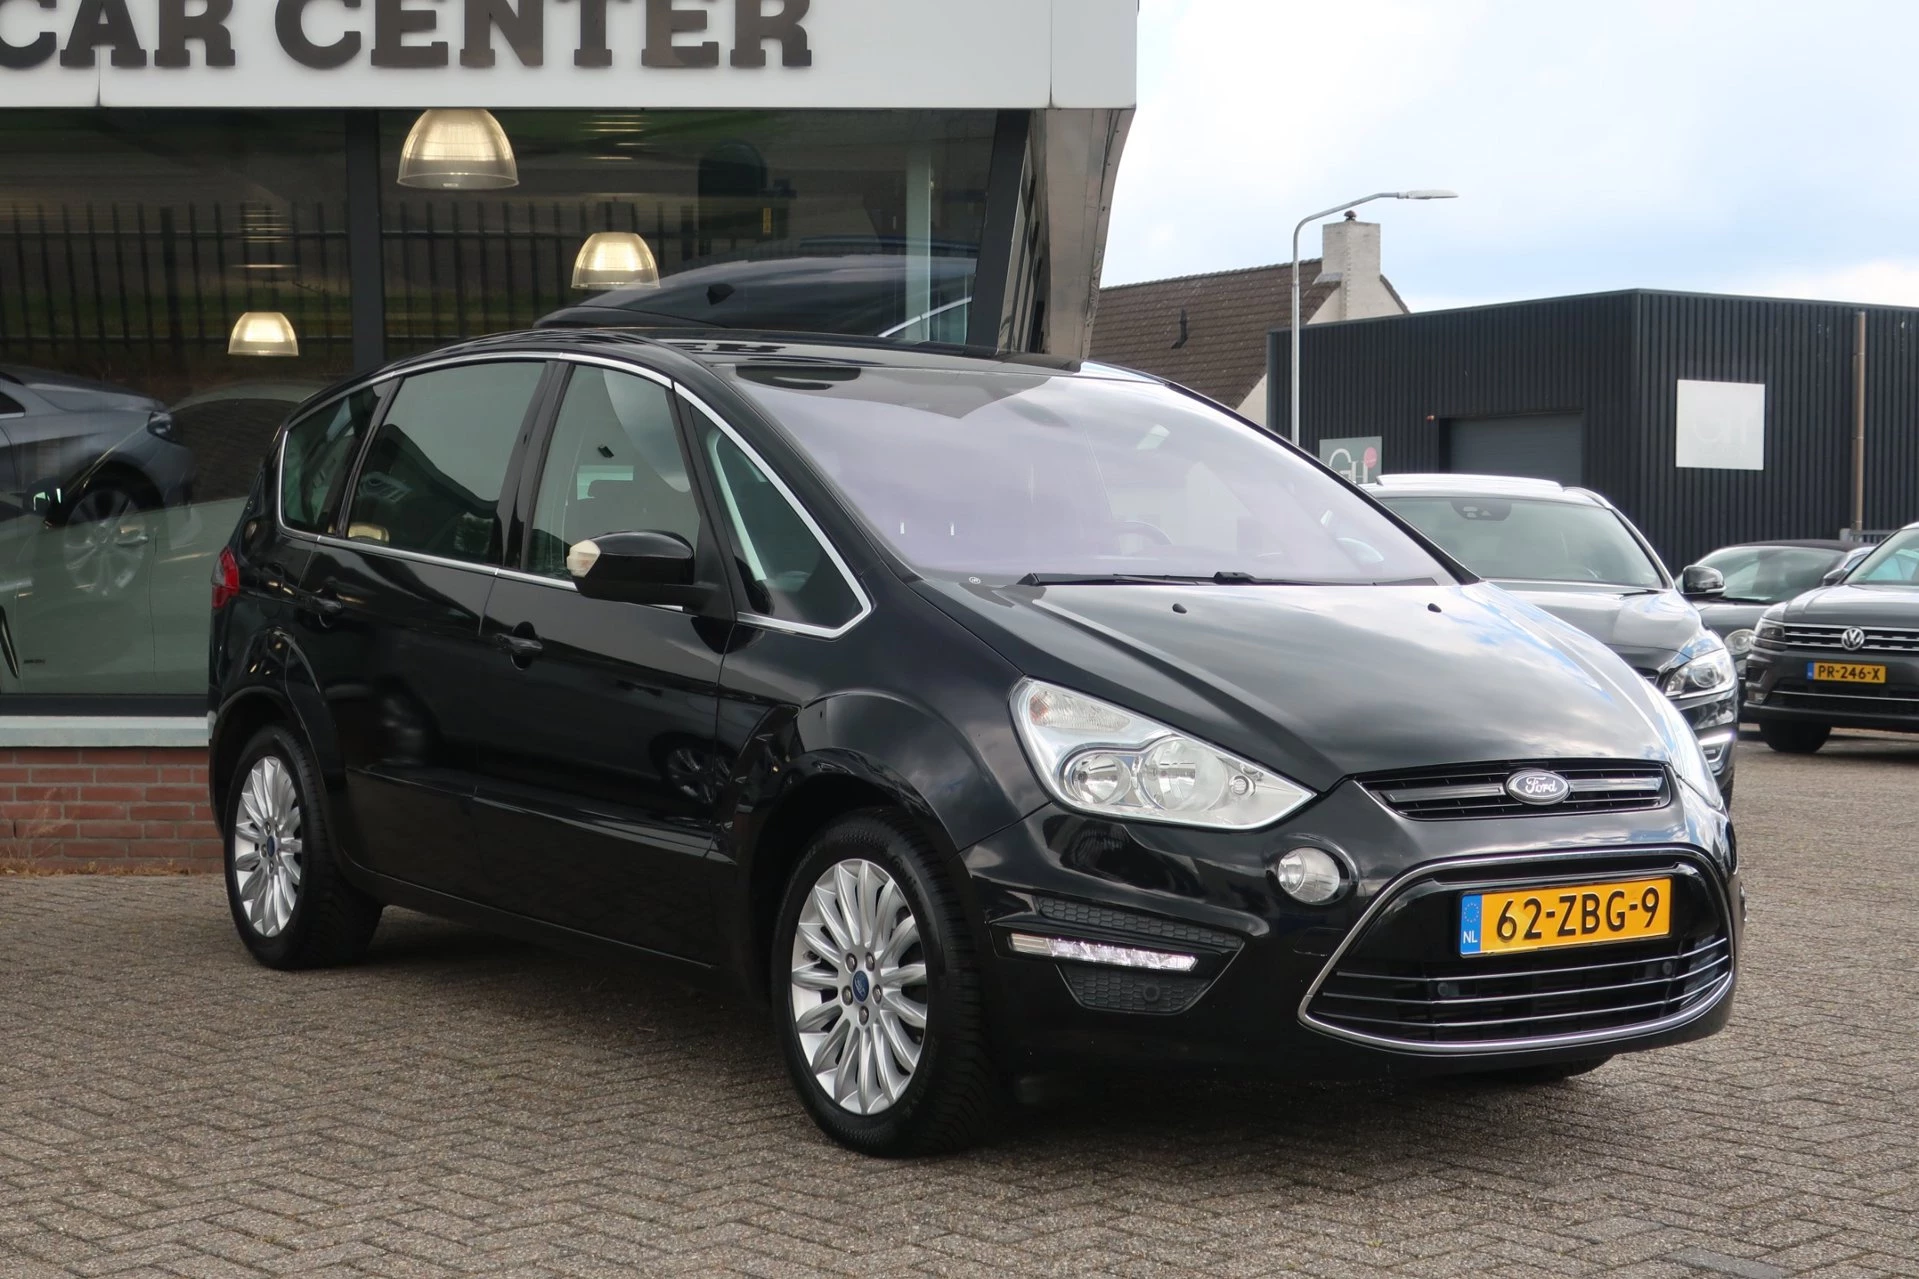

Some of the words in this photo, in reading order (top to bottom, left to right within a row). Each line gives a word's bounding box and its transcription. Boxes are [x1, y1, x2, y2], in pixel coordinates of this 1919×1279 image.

[0, 0, 236, 69] CAR
[274, 0, 813, 69] CENTER
[1817, 664, 1881, 681] PR-246-X
[1525, 776, 1558, 794] Ford
[1462, 929, 1478, 944] NL
[1496, 886, 1660, 942] 62-ZBG-9
